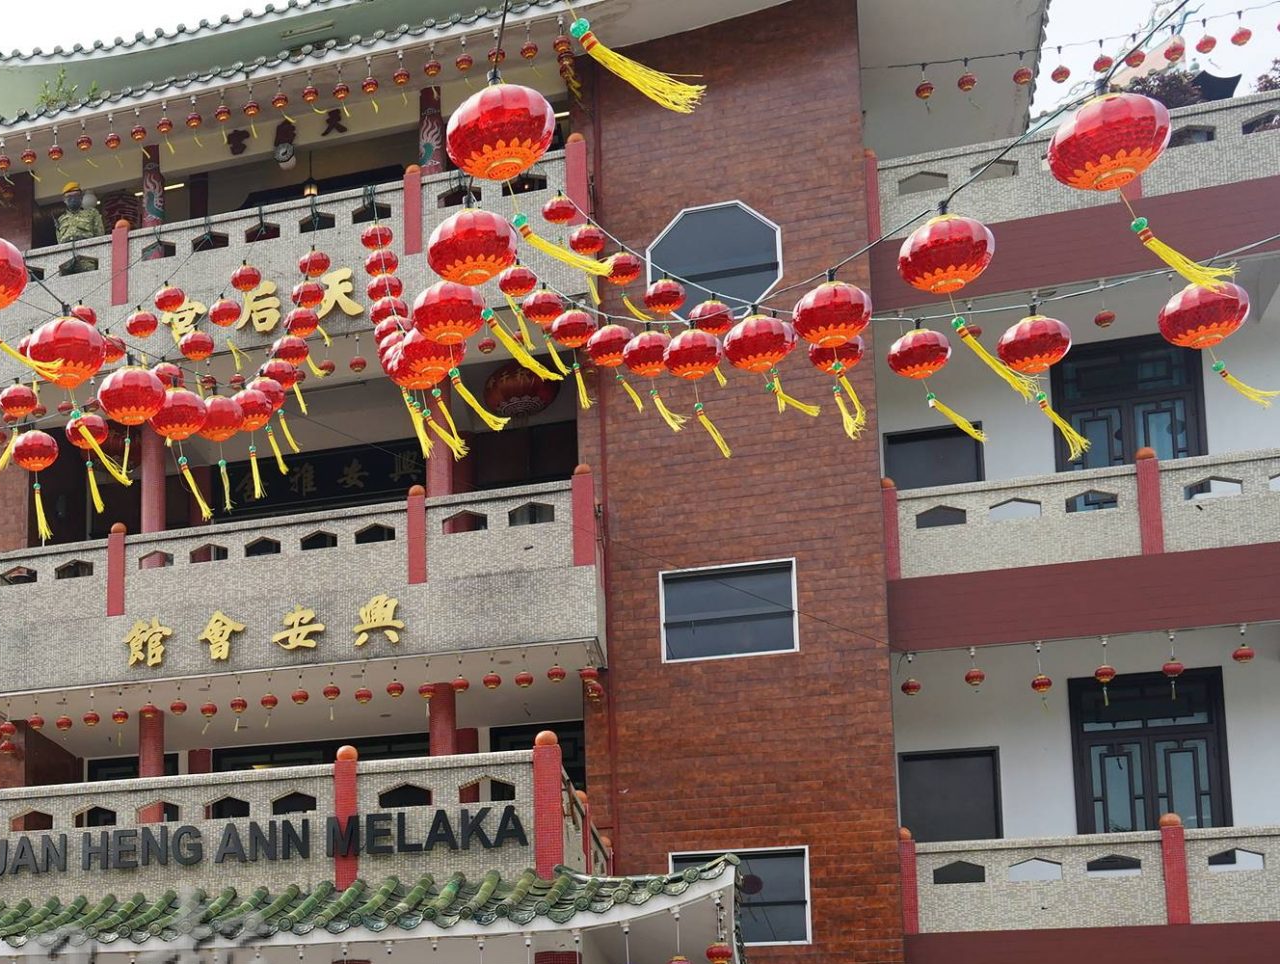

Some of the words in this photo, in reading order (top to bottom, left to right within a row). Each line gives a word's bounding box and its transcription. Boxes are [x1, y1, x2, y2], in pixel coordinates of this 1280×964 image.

[82, 825, 203, 871] HENG
[214, 819, 311, 863] ANN
[326, 805, 530, 858] MELAKA
